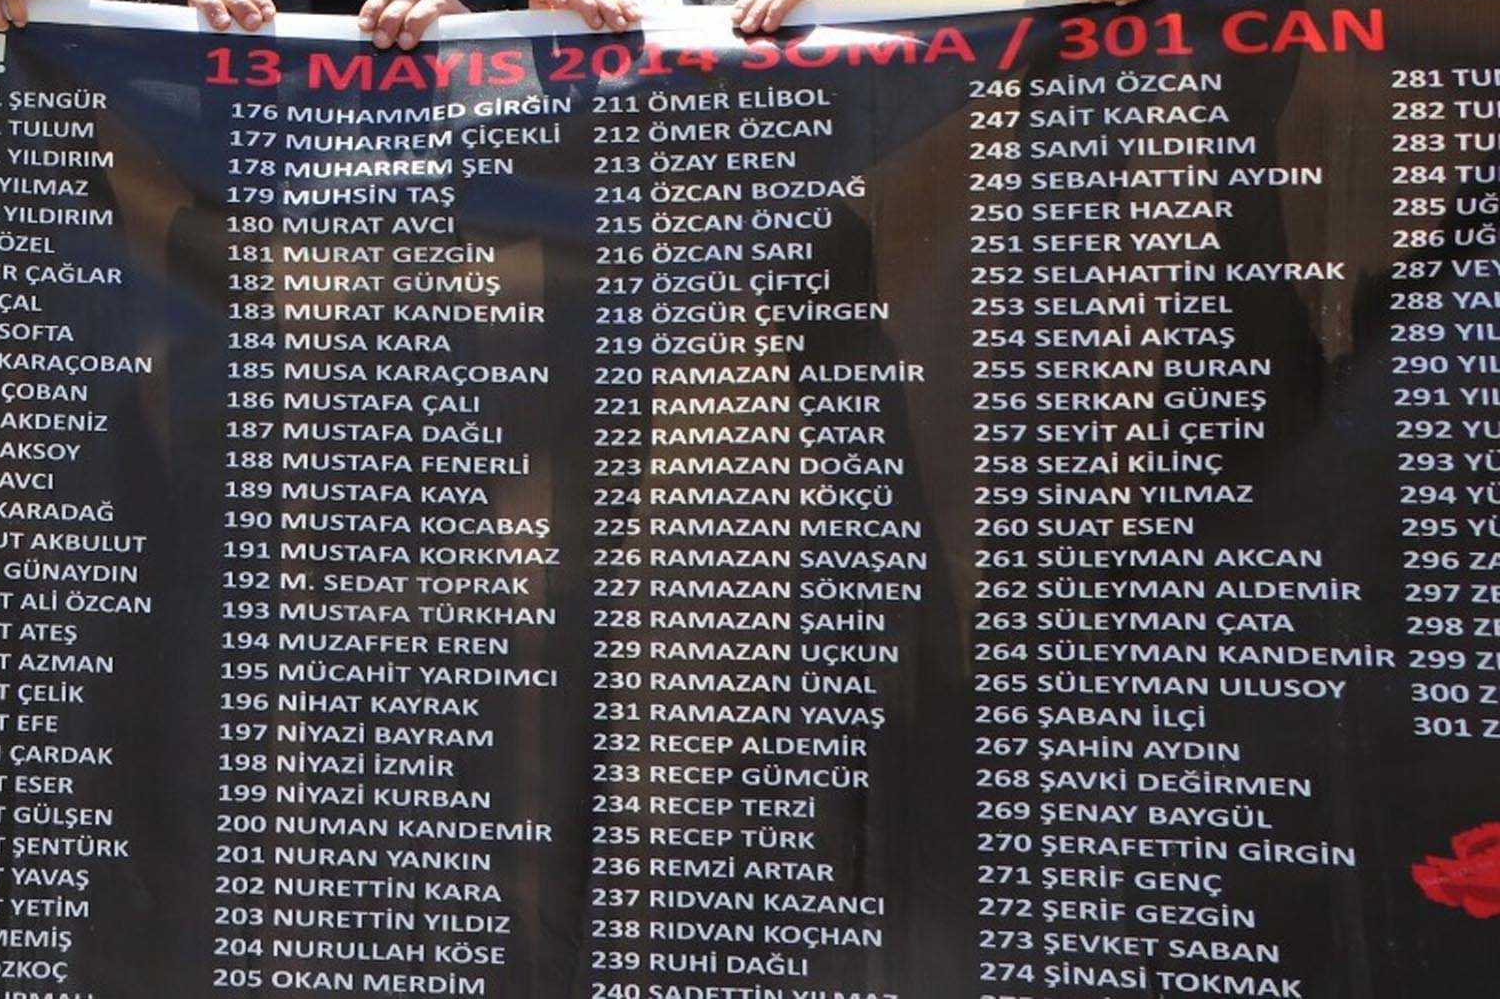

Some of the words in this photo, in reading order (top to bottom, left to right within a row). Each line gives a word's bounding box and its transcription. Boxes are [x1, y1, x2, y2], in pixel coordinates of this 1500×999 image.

[206, 48, 281, 87] 13
[307, 50, 527, 91] MAYIS
[549, 42, 719, 81] 2014
[743, 26, 976, 70] SOMA
[999, 17, 1031, 69] /
[1060, 12, 1194, 59] 301
[1221, 8, 1385, 55] CAN
[970, 80, 1020, 97] 246
[1031, 75, 1105, 95] SAİM
[1117, 74, 1221, 92] ÖZCAN
[1392, 70, 1443, 88] 281
[1452, 69, 1500, 86] TU
[10, 89, 106, 110] ŞENGÜR
[232, 103, 277, 120] 176
[288, 103, 466, 124] MUHAMMED
[474, 95, 570, 116] GİRĞİN
[593, 96, 639, 112] 211
[649, 91, 729, 111] ÖMER
[739, 89, 830, 108] ELİBOL
[26, 263, 121, 285] ÇAĞLAR
[230, 274, 274, 290] 182
[285, 275, 384, 291] MURAT
[394, 273, 500, 296] GÜMÜŞ
[597, 278, 643, 294] 217
[652, 273, 742, 292] ÖZGÜL
[750, 273, 829, 296] ÇİFTÇİ
[971, 267, 1023, 284] 252
[1034, 265, 1215, 283] SELAHATTİN
[1227, 262, 1344, 281] KAYRAK
[1392, 356, 1448, 373] 290
[227, 422, 273, 438] 187
[284, 423, 412, 441] MUSTAFA
[423, 422, 501, 443] DAĞLI
[975, 456, 1027, 473] 258
[1038, 457, 1118, 473] SEZAİ
[1129, 454, 1222, 475] KİLİNÇ
[223, 602, 269, 619] 193
[280, 603, 410, 622] MUSTAFA
[419, 603, 555, 624] TÜRKHAN
[594, 610, 641, 627] 228
[651, 611, 790, 629] RAMAZAN
[801, 613, 884, 634] ŞAHİN
[976, 613, 1027, 629] 263
[1038, 608, 1206, 630] SÜLEYMAN
[1217, 613, 1294, 635] ÇATA
[20, 624, 77, 645] ATEŞ
[1414, 717, 1472, 736] 301
[220, 754, 266, 771] 198
[278, 752, 364, 773] NİYAZİ
[375, 755, 453, 776] İZMİR
[16, 776, 73, 793] ESER
[593, 795, 641, 812] 234
[651, 797, 733, 815] RECEP
[741, 797, 814, 817] TERZİ
[977, 801, 1030, 819] 269
[1041, 803, 1137, 825] ŞENAY
[1149, 805, 1272, 828] BAYGÜL
[215, 938, 263, 956] 204
[274, 940, 424, 961] NURULLAH
[436, 943, 504, 964] KÖSE
[592, 951, 639, 969] 239
[650, 954, 716, 972] RUHİ
[728, 953, 807, 975] DAĞLI
[981, 963, 1034, 982] 274
[1044, 966, 1146, 988] ŞİNASİ
[1156, 972, 1301, 998] TOKMAK
